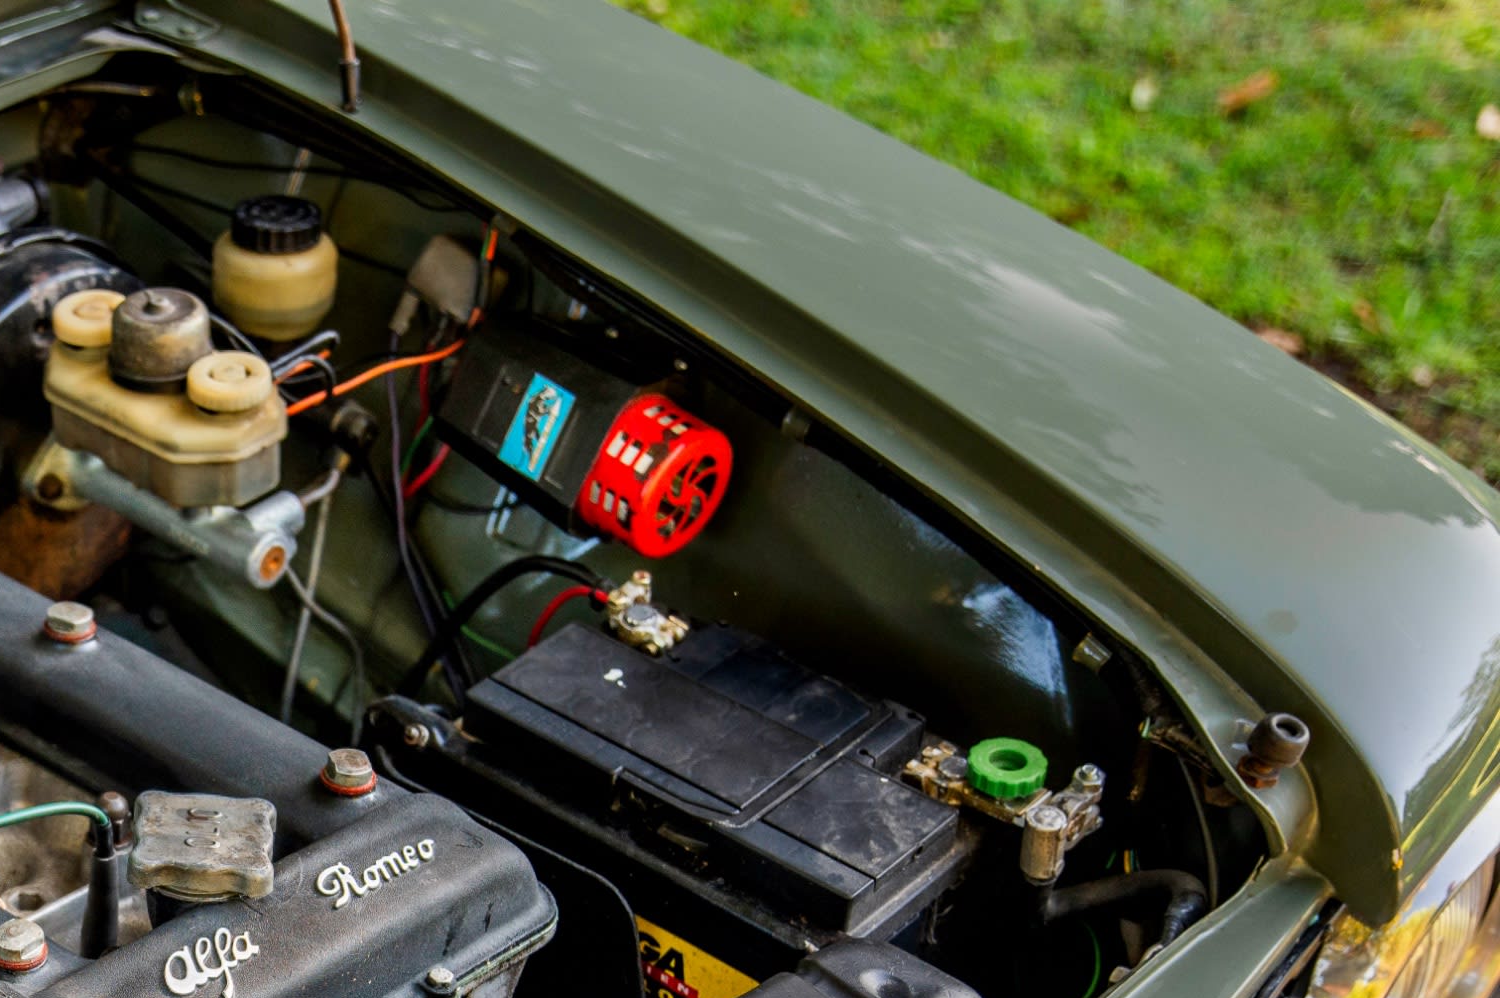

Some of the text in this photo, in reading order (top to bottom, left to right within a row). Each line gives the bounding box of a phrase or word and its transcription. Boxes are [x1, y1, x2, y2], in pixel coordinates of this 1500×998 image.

[316, 839, 435, 909] Romeo
[638, 931, 685, 983] GA
[646, 965, 690, 997] IEN
